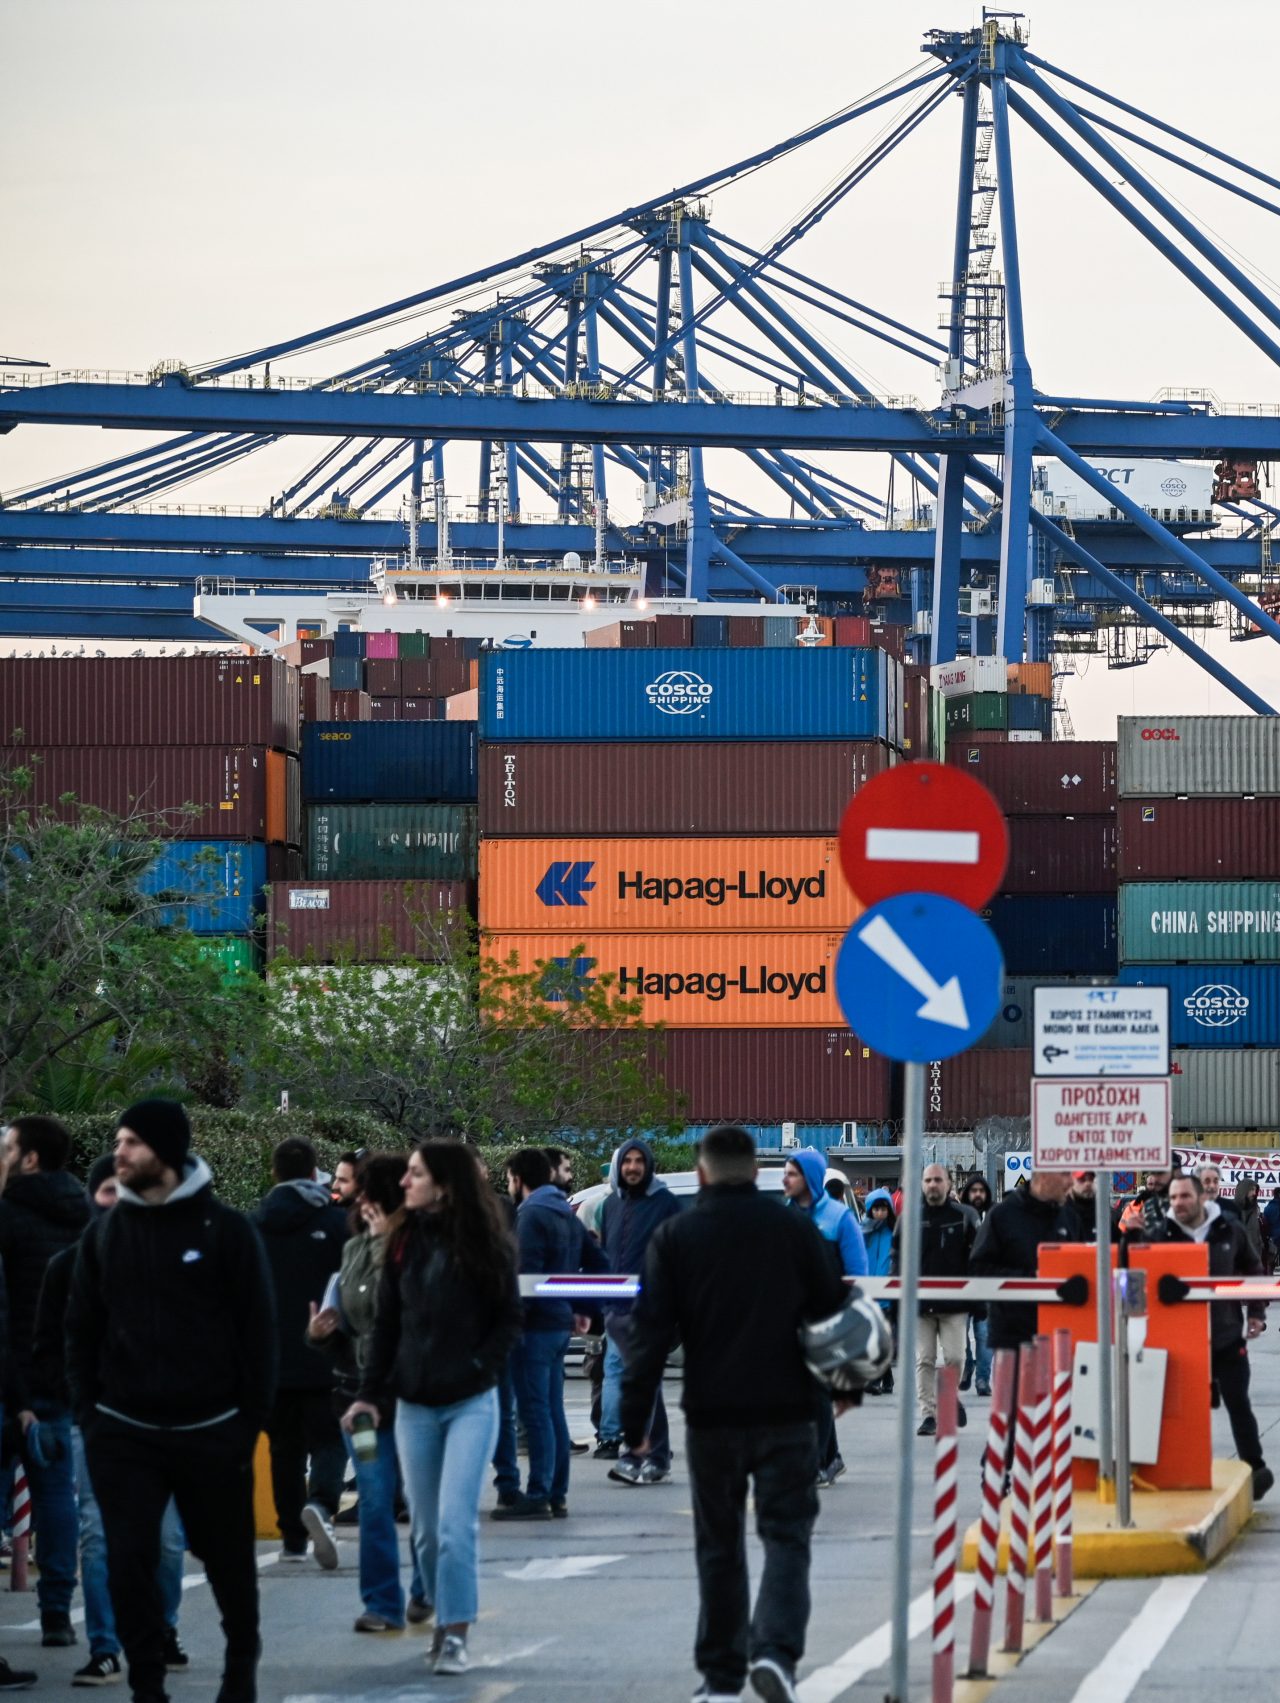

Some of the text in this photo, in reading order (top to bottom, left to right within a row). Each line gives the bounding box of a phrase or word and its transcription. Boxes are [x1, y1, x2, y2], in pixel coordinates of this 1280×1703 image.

[645, 684, 713, 696] COSCO
[648, 696, 710, 704] SHIPPING
[320, 732, 352, 740] seaco
[1141, 728, 1180, 741] OOCL
[504, 755, 516, 807] TRITON
[618, 870, 826, 905] Hapag-Lloyd
[1151, 911, 1199, 934] CHINA
[618, 966, 827, 1001] Hapag-Lloyd
[1183, 996, 1250, 1009] COSCO
[1186, 1009, 1247, 1017] SHIPPING
[930, 1061, 942, 1111] TRITON
[1061, 1086, 1141, 1107] ΠΡΟΣΟΧΗ
[1055, 1111, 1148, 1126] ΟΔΗΓΕΙΤΕ ΑΡΓΑ
[1069, 1129, 1134, 1145] ΕΝΤΟΣ ΤΟΥ
[1040, 1146, 1162, 1162] ΧΩΡΟΥ ΣΤΑΘΜΕΥΣΗΣ
